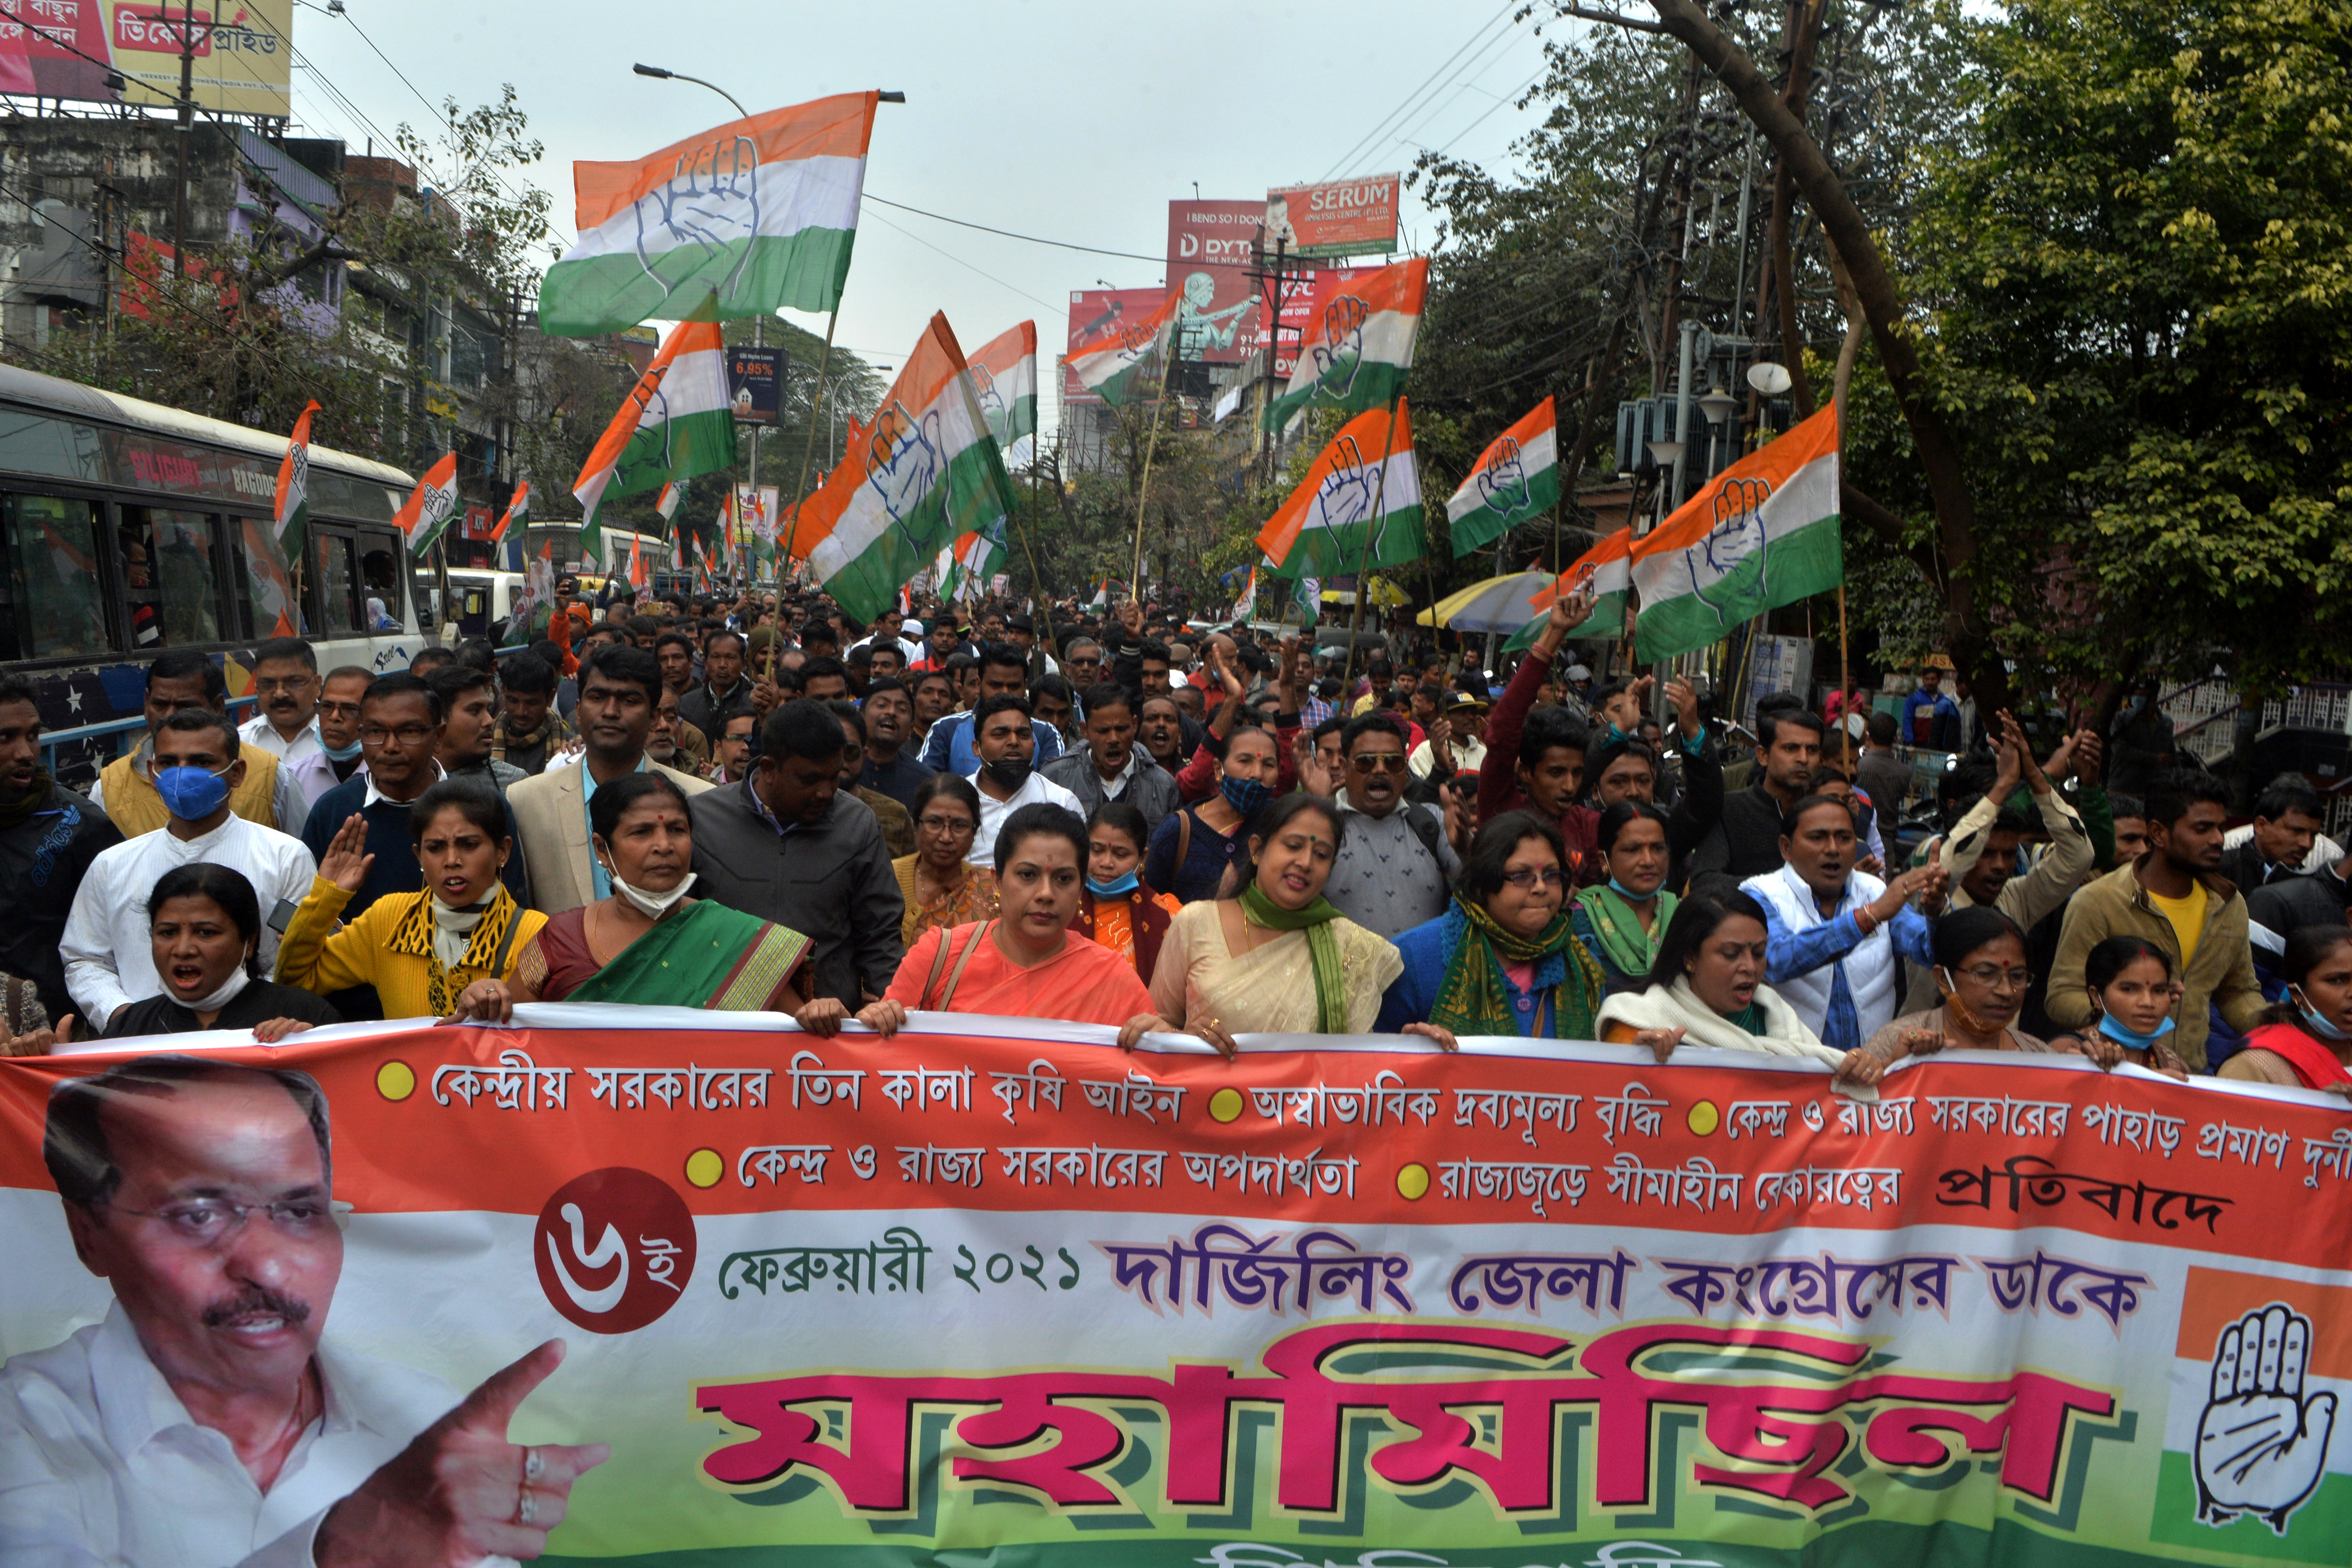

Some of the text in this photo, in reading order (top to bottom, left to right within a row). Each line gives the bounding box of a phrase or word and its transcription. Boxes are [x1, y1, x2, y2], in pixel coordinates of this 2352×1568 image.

[213, 24, 278, 56] প্রাইড
[1191, 213, 1217, 224] BEND
[1219, 214, 1232, 224] SO
[1239, 215, 1267, 226] DON'
[1305, 213, 1336, 223] ANALYSIS
[1337, 211, 1362, 219] CENTRE
[1310, 183, 1389, 211] SERUM
[1205, 239, 1252, 255] DYT
[1280, 281, 1314, 298] KFC
[1280, 307, 1310, 316] NOW OPEN
[736, 361, 773, 376] 6.95%
[129, 450, 201, 487] SILIGURI
[232, 468, 277, 498] BAGDOG
[32, 821, 73, 887] adidas
[431, 1049, 1187, 1125] কেন্দ্রীয় সরকারের তিন কালা কৃষি আইন
[1248, 1069, 1670, 1148] অস্বাভাবিক দ্রব্যমূল্য বৃদ্ধি
[1726, 1100, 1793, 1140] কেন্দ্র
[1801, 1103, 1825, 1133] ও
[1835, 1095, 1916, 1137] রাজ্য
[1925, 1094, 2072, 1139] সরকারের
[2081, 1101, 2188, 1159] পাহাড়
[2196, 1119, 2292, 1171] প্রমাণ
[737, 1142, 1361, 1200] কেন্দ্র ও রাজ্য সরকারের অপদার্থতা
[1603, 1152, 1744, 1213] সীমাহীন
[1754, 1163, 1904, 1212] বেকারত্বের
[1936, 1154, 2235, 1235] প্রতিবাদে
[546, 1202, 684, 1315] ৬ ই
[719, 1224, 2147, 1325] ফেব্রুয়ারী ২০২১ দার্জিলিং জেলা কংগ্রেসের ডাকে
[692, 1319, 2119, 1515] মহামিছিল
